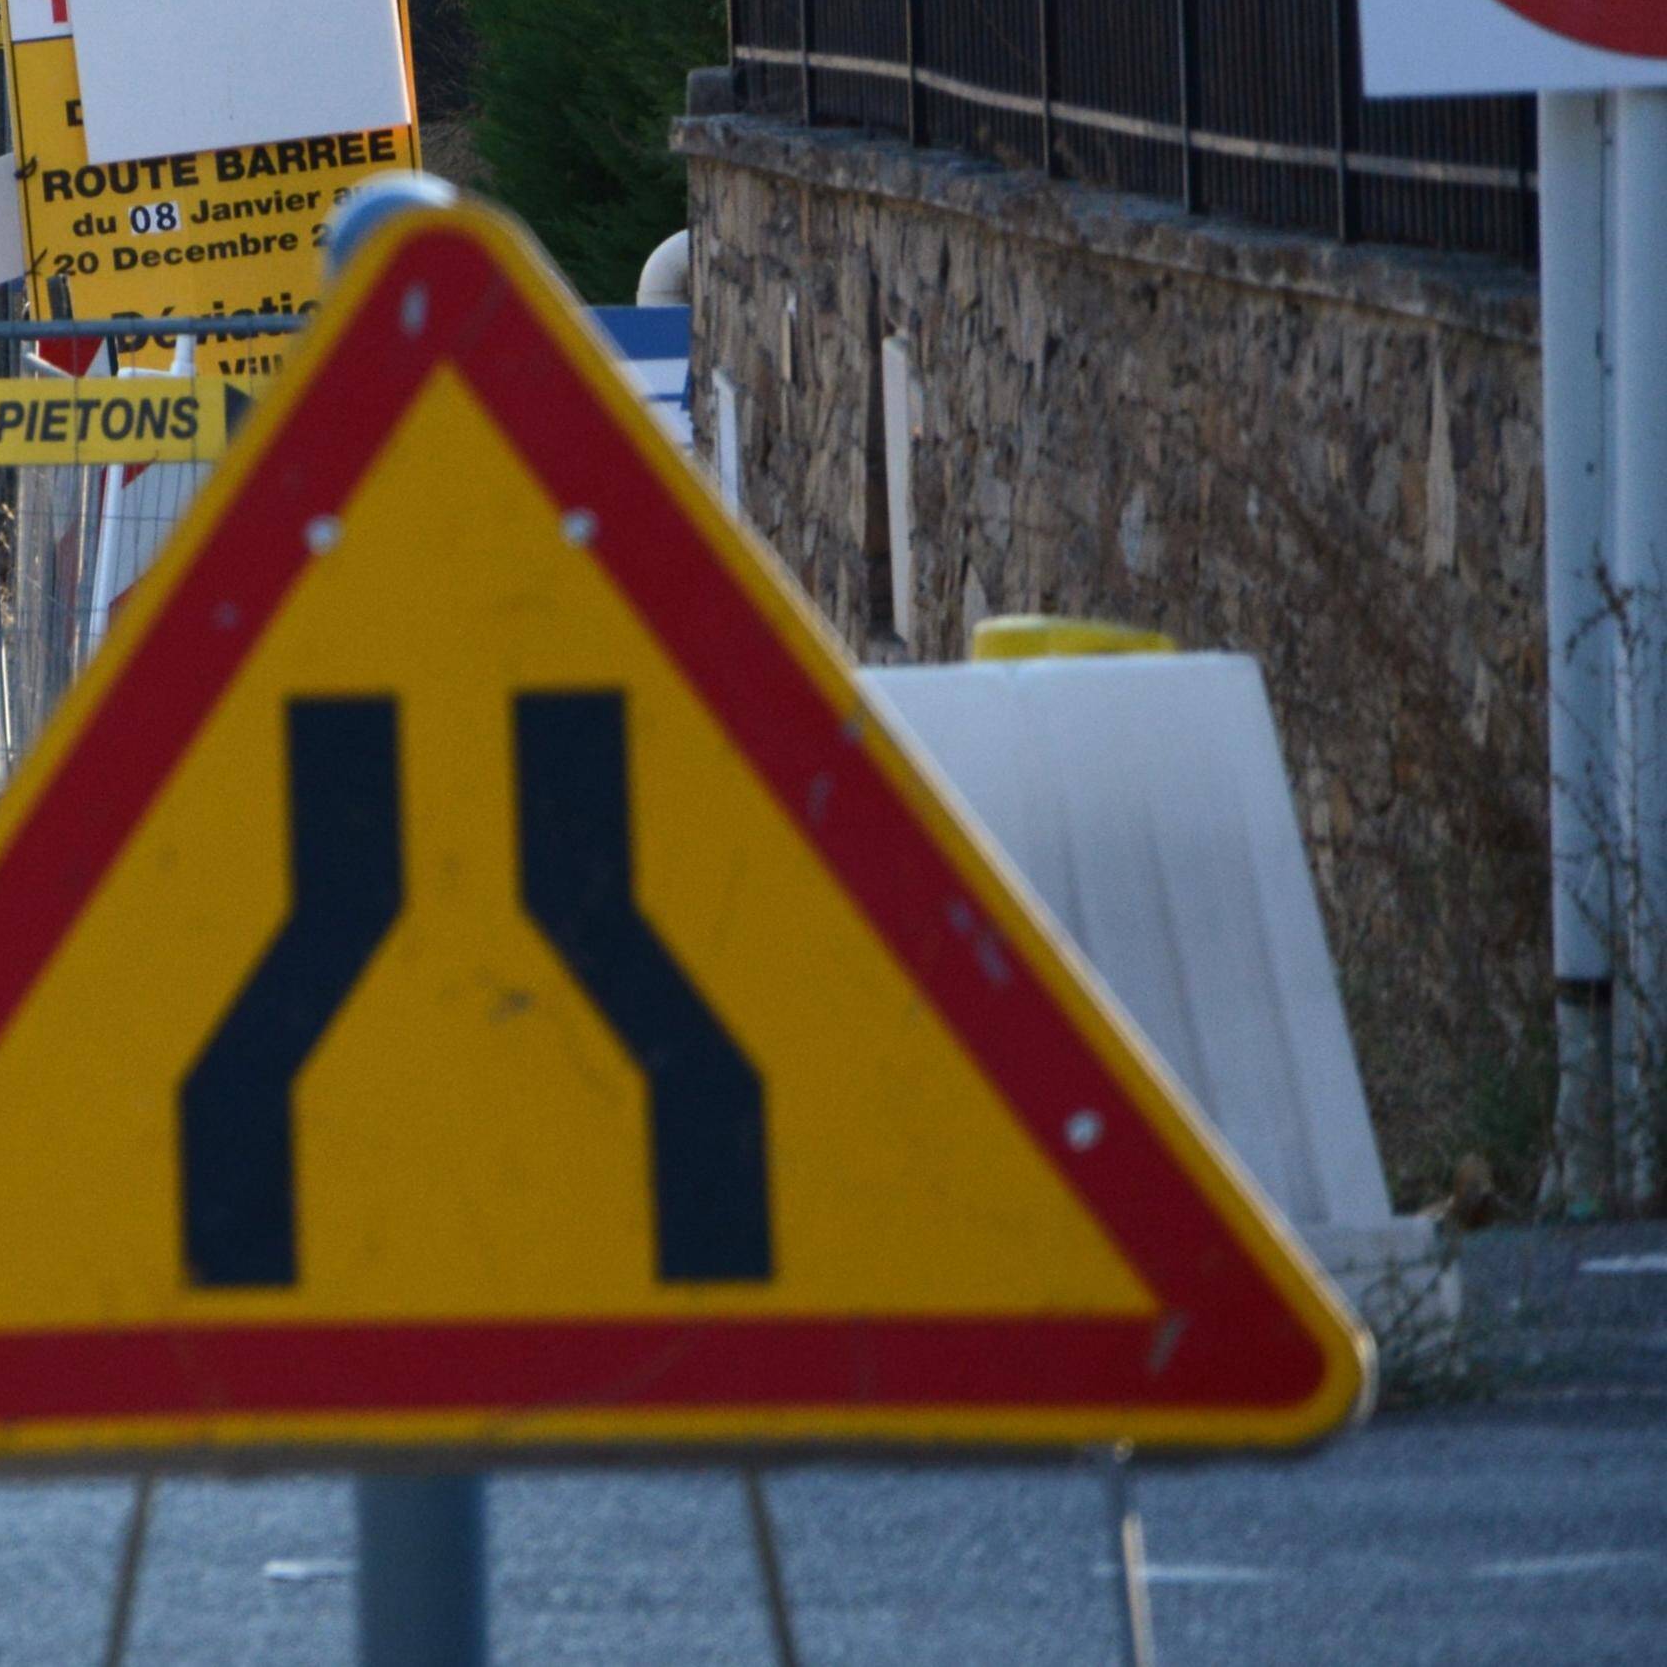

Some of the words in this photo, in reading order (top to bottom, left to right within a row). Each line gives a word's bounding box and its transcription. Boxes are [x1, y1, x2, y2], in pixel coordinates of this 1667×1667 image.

[41, 154, 200, 203] ROUTE
[72, 212, 117, 238] du
[129, 202, 178, 235] 08
[189, 189, 321, 225] Janvier
[53, 251, 99, 277] 20
[112, 230, 299, 273] Decembre
